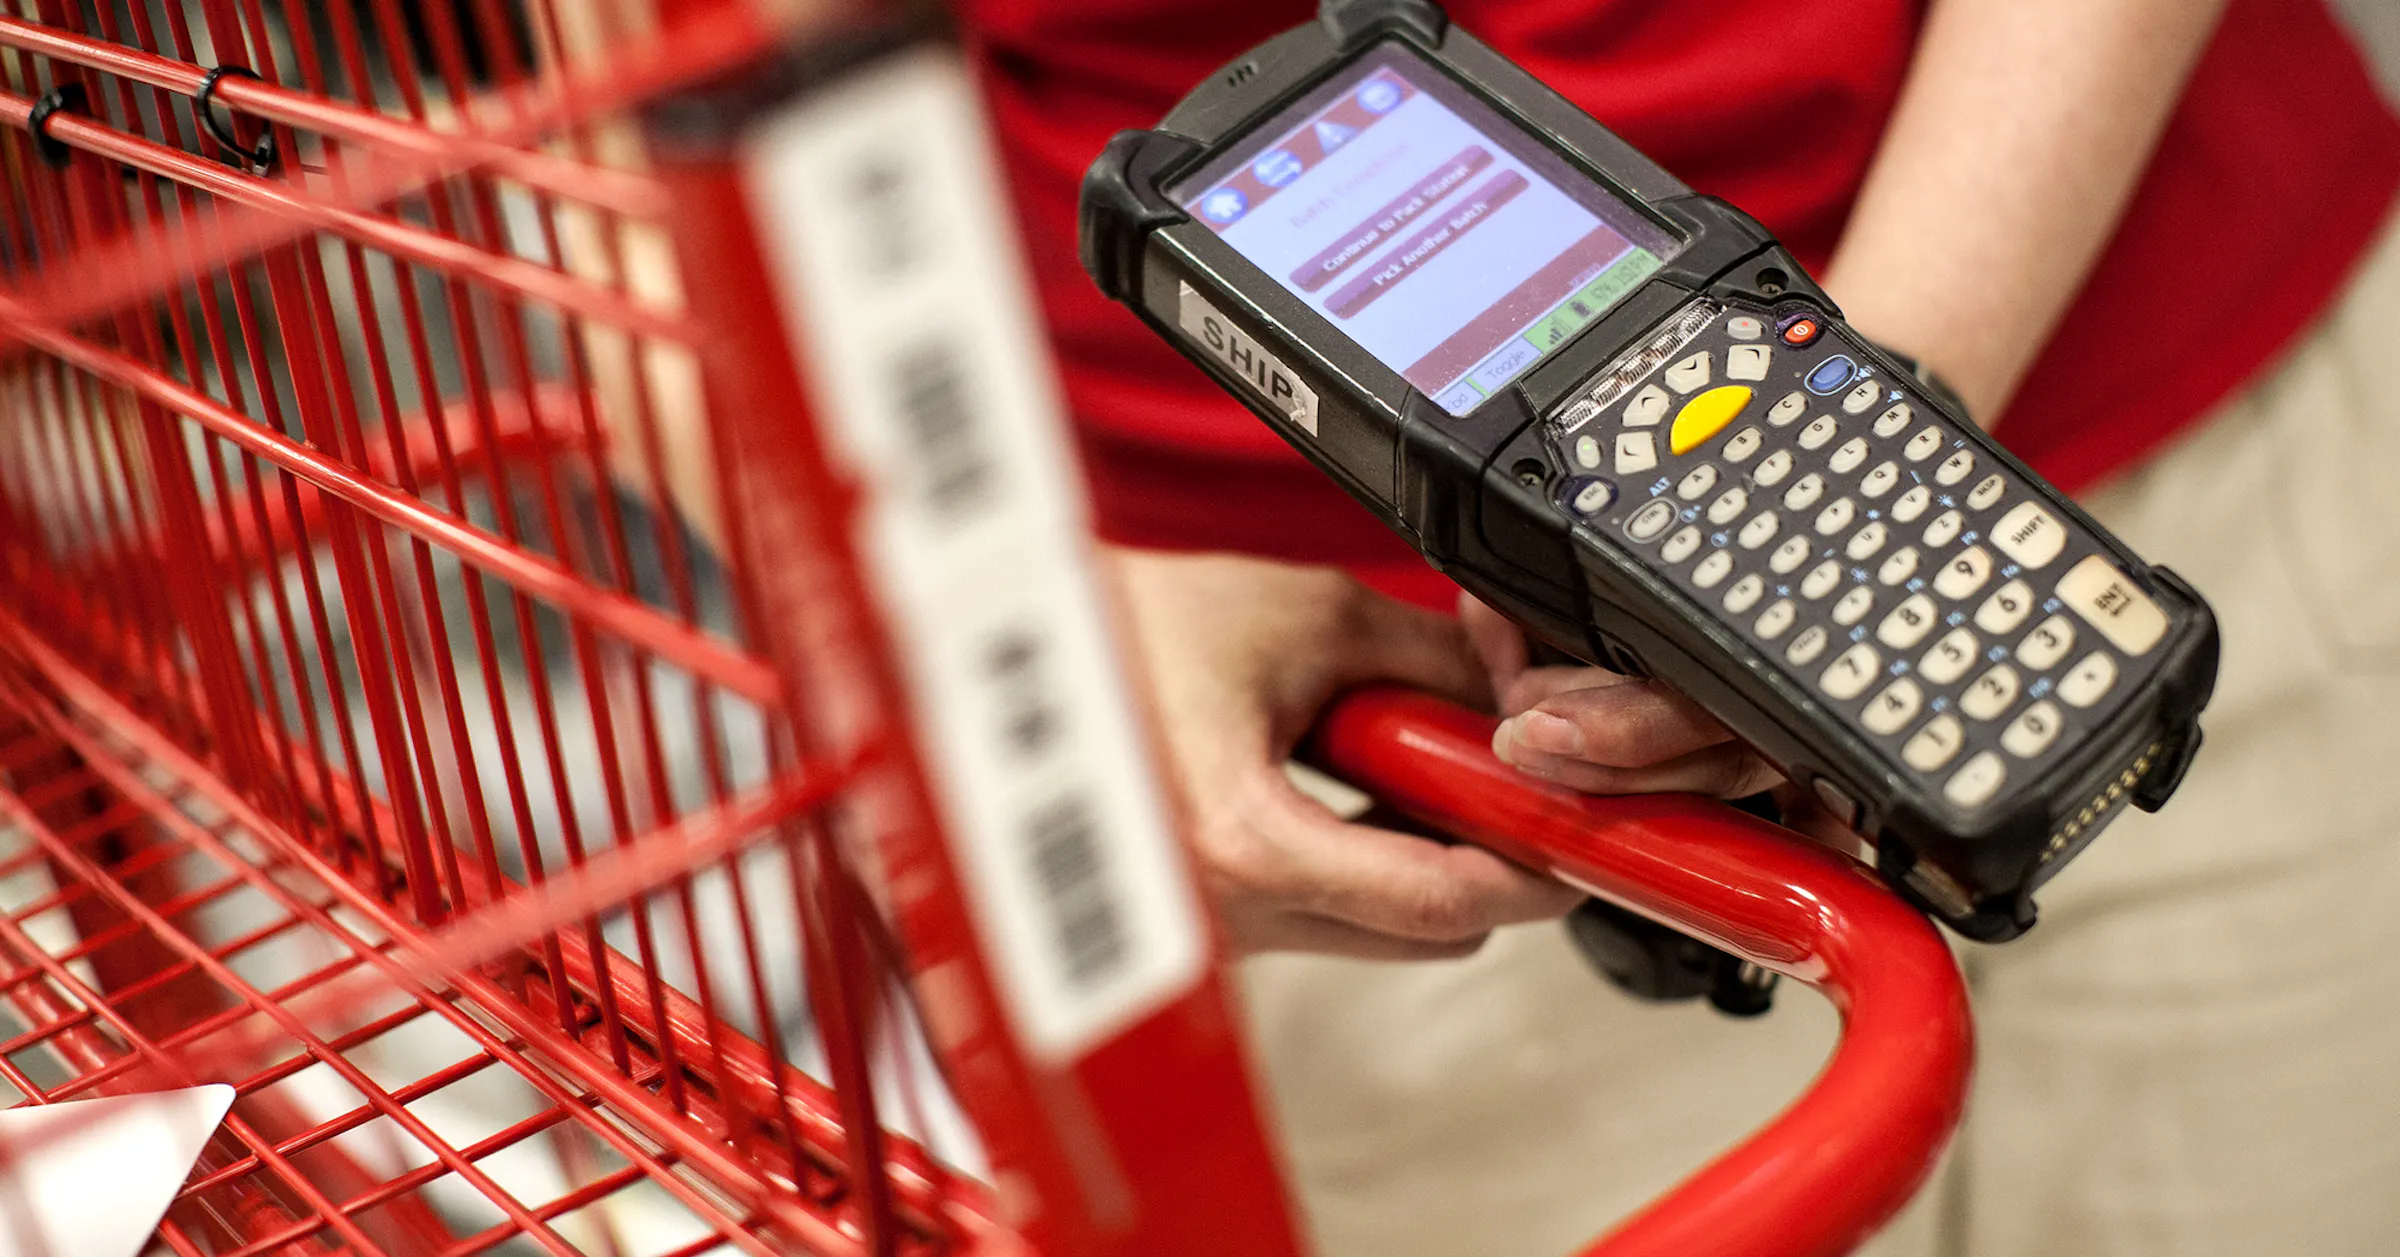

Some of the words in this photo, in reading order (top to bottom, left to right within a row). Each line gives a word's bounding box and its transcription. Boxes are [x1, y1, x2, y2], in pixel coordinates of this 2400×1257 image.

[1322, 229, 1380, 272] Continue
[1377, 217, 1396, 233] to
[1392, 195, 1425, 223] Pack
[1423, 164, 1470, 199] Station
[1372, 259, 1404, 286] Pick
[1402, 226, 1451, 267] Another
[1449, 200, 1489, 231] Batch
[1202, 315, 1293, 399] SHIP
[1486, 350, 1527, 380] Toggle
[1649, 476, 1671, 497] ALT
[2010, 514, 2045, 545] SHIFT
[1954, 560, 1975, 576] 9
[1996, 593, 2017, 613] 6
[1899, 607, 1921, 627] 8
[2035, 628, 2058, 649] 3
[1942, 642, 1962, 663] 5
[1840, 657, 1859, 676] 7
[1981, 676, 2004, 696] 2
[1885, 692, 1905, 711] 4
[2022, 713, 2045, 736] 0
